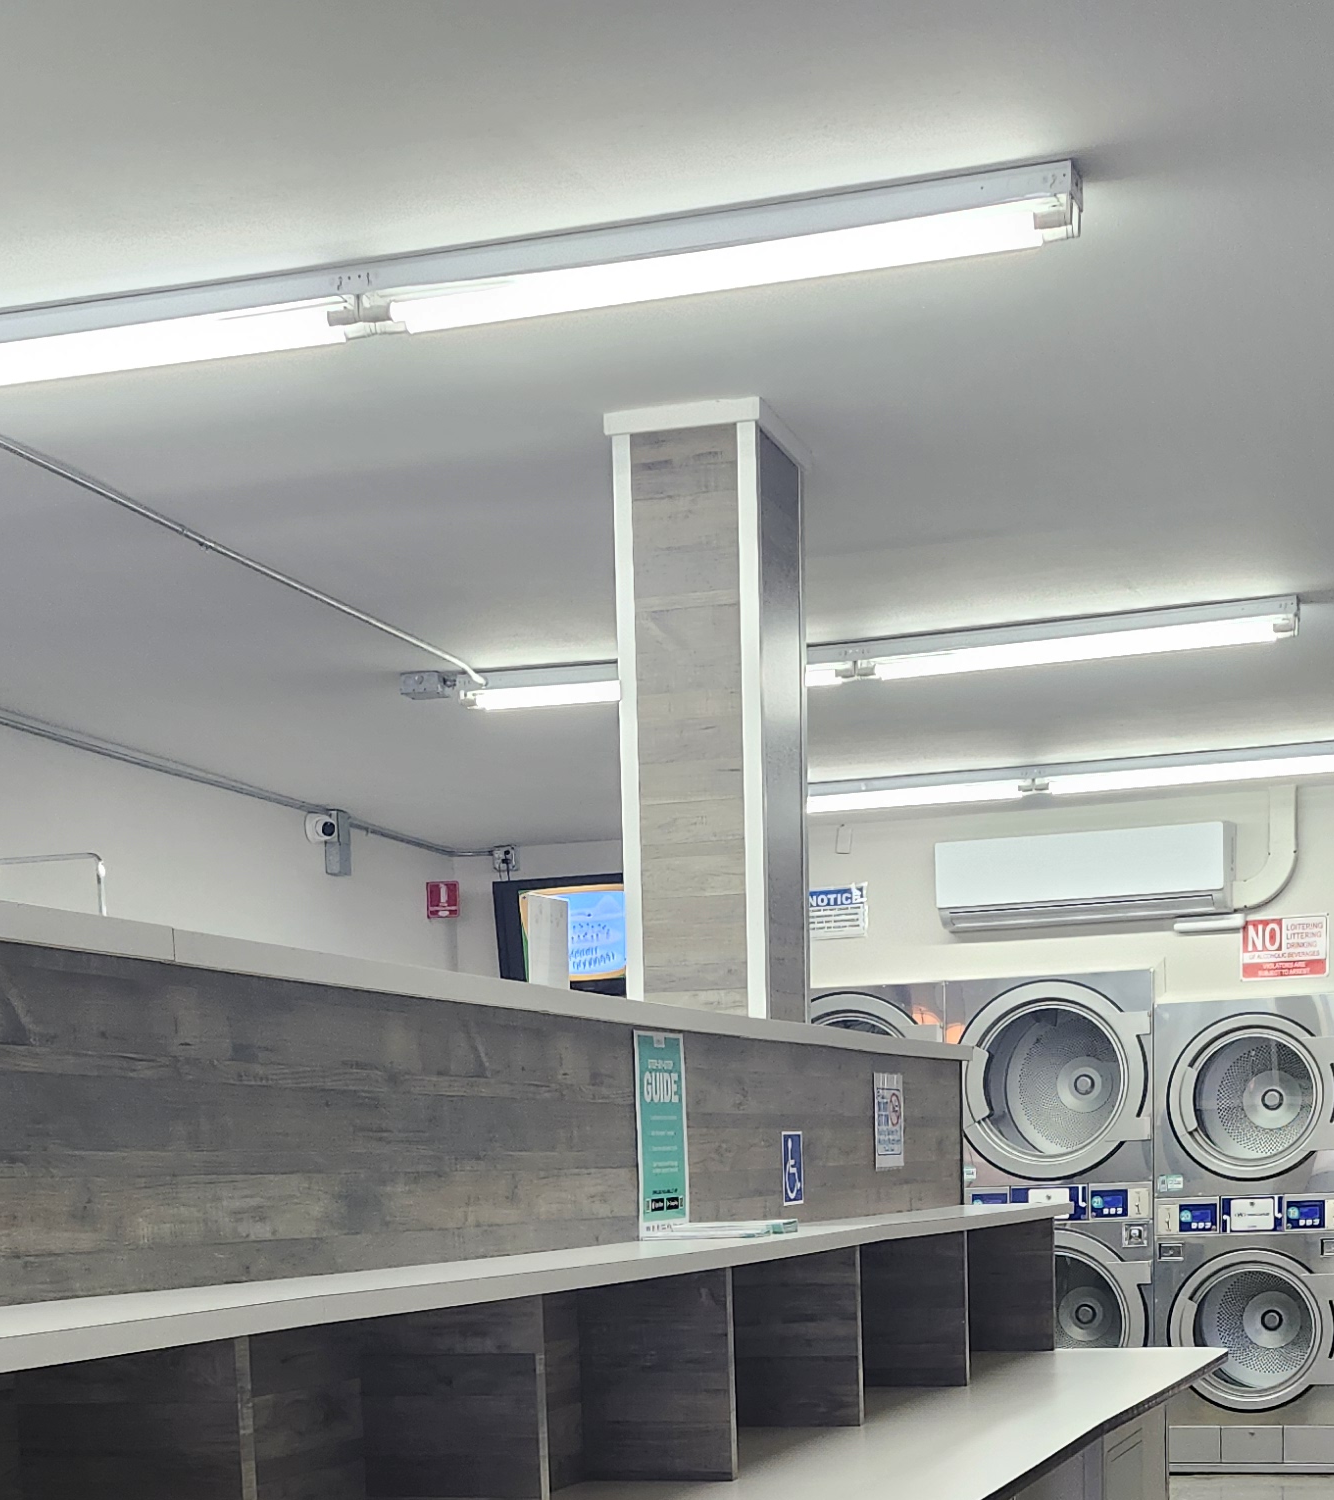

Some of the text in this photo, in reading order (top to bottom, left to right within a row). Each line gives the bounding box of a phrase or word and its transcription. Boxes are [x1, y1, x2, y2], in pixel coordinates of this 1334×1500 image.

[809, 893, 861, 907] NOTICE
[1248, 922, 1323, 951] NO LOITERING
[1286, 931, 1322, 940] LITTERING
[1286, 940, 1317, 949] DRINKING
[1287, 950, 1320, 958] BEVERAGES
[644, 1071, 679, 1103] GUIDE
